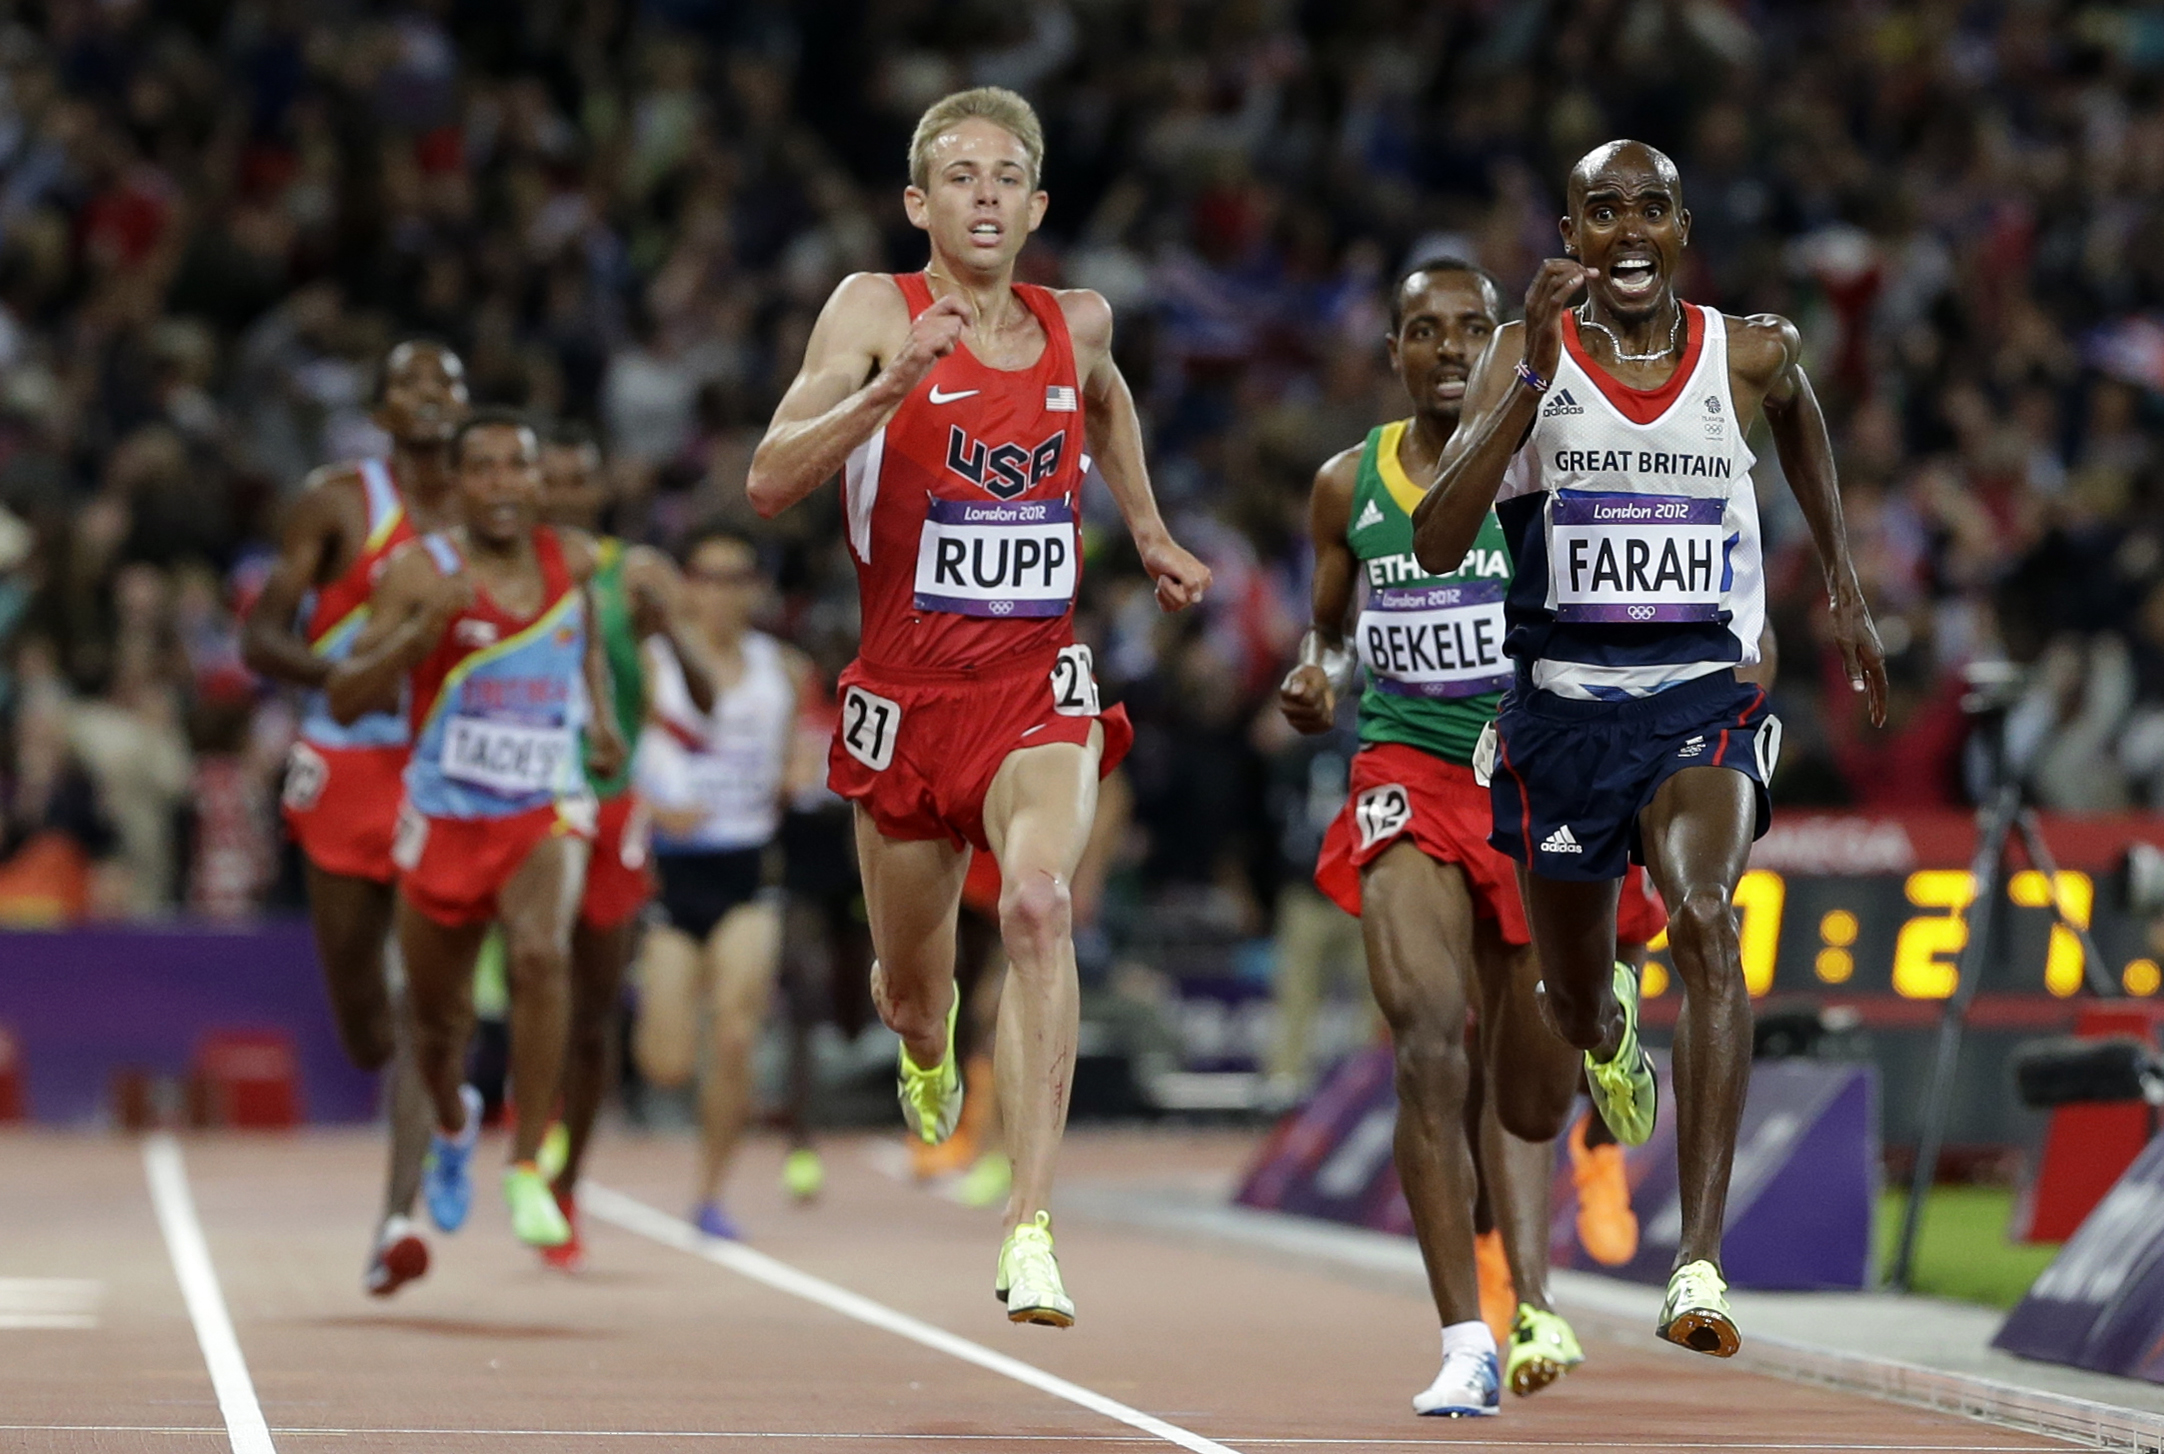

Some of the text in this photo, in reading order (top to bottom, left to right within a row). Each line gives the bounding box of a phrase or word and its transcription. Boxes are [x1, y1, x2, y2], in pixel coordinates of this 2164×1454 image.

[1542, 404, 1585, 417] adidas
[946, 422, 1066, 501] USA
[1555, 450, 1732, 479] GREAT BRITAIN
[963, 505, 1046, 521] London 2012
[1593, 502, 1689, 519] London 2012
[934, 537, 1066, 588] RUPP
[1367, 549, 1510, 586] ETHPIA
[1569, 537, 1713, 592] FARAH
[1382, 589, 1461, 607] London 2012
[1367, 618, 1498, 671] BEKELE
[846, 692, 890, 761] 21
[1365, 790, 1406, 839] 12
[1540, 841, 1583, 853] adidas
